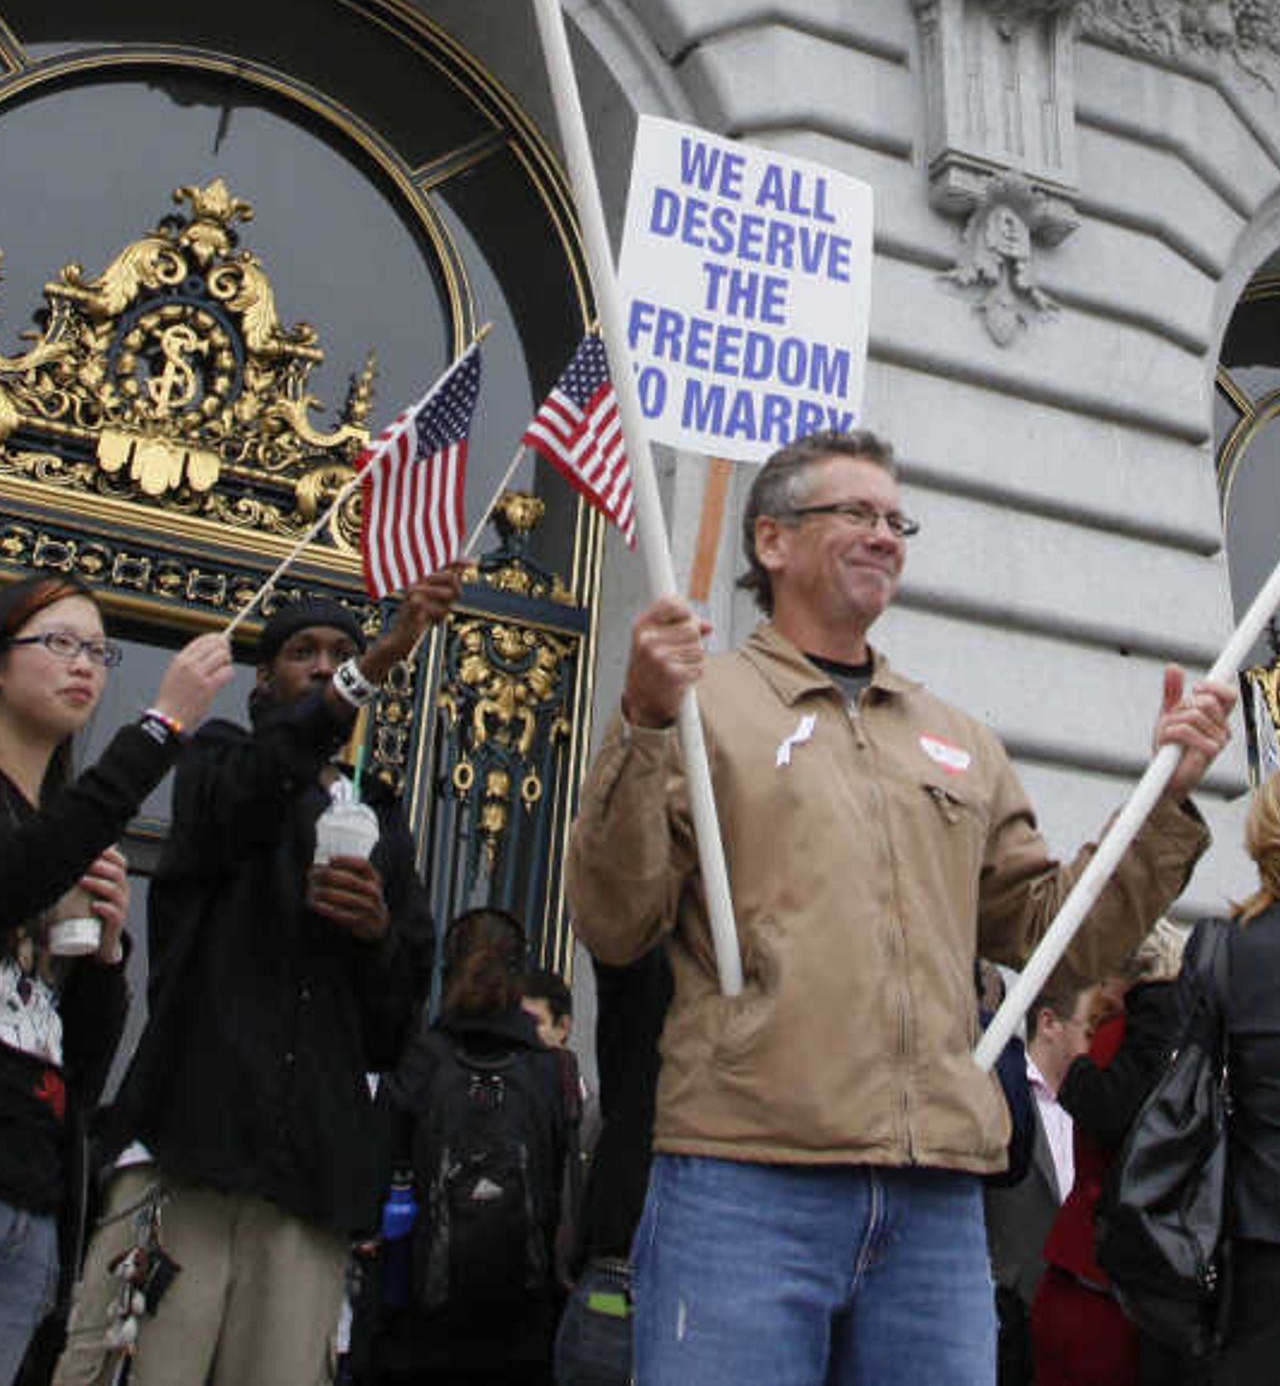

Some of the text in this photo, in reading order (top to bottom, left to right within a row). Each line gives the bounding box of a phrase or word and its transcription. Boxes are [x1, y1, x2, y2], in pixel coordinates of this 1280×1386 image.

[681, 137, 836, 224] WE ALL
[649, 188, 852, 282] DESERVE
[703, 262, 789, 325] THE
[628, 300, 850, 399] FREEDOM
[633, 362, 668, 419] O
